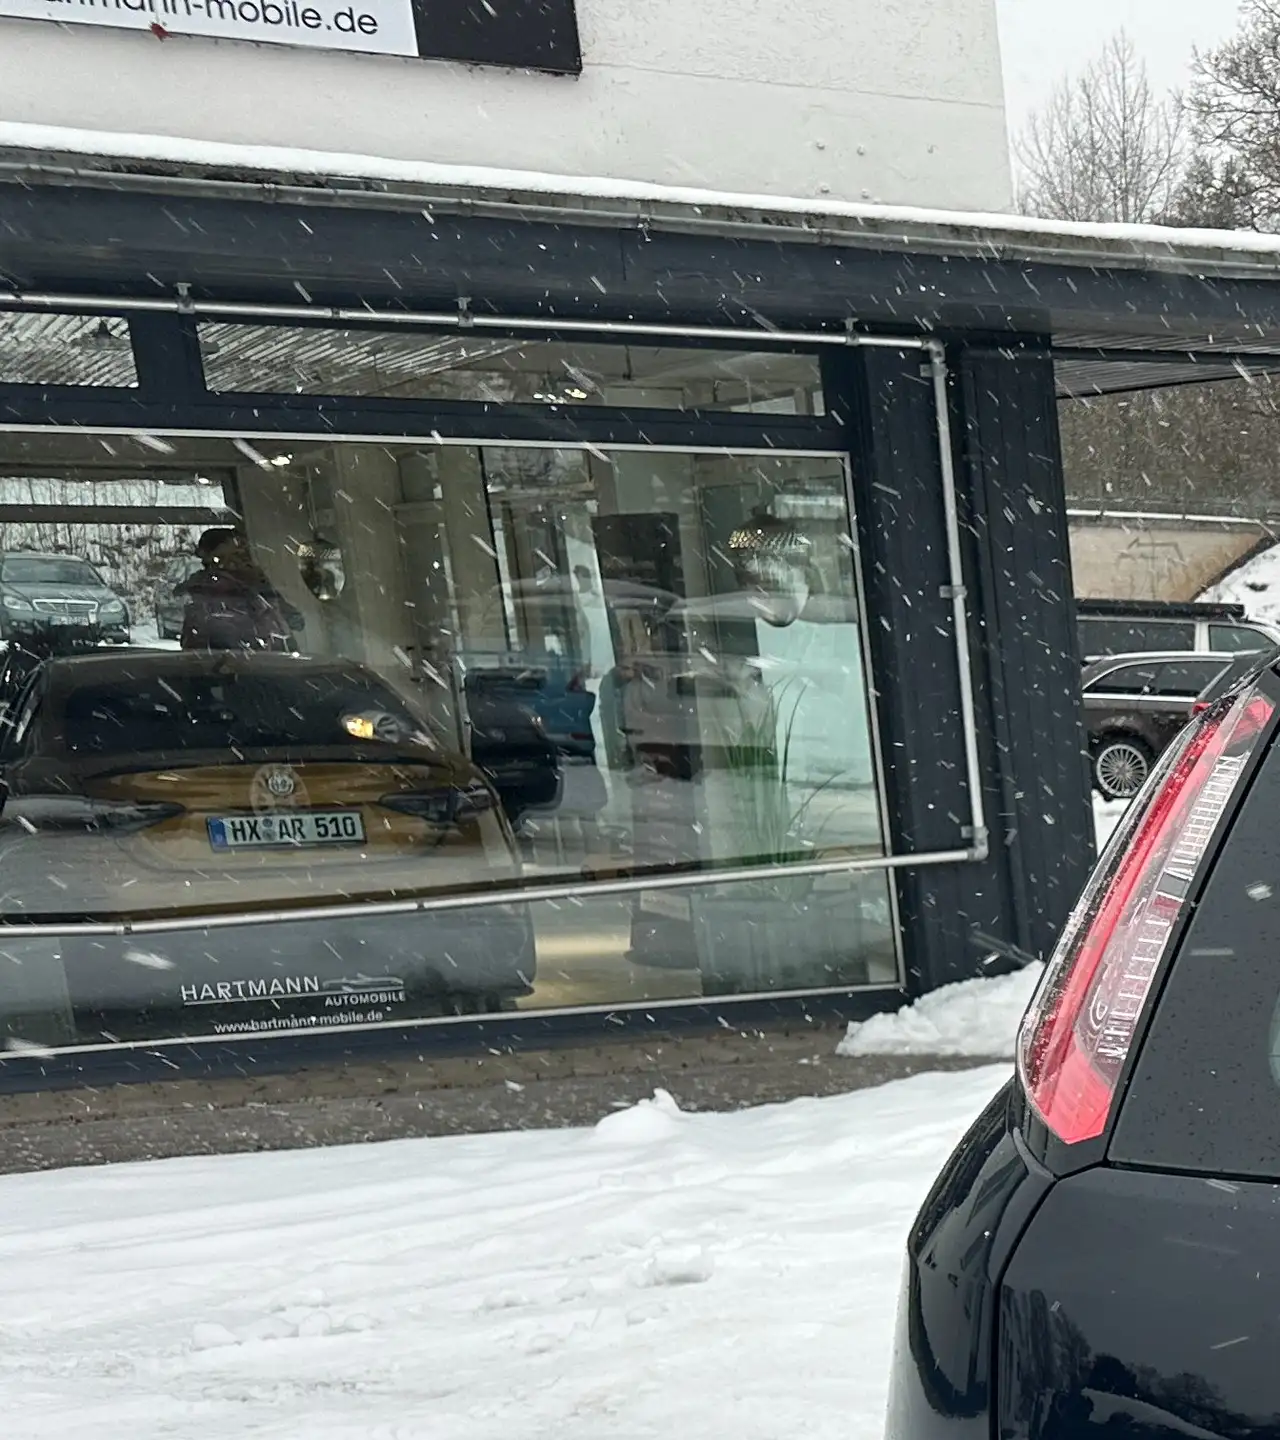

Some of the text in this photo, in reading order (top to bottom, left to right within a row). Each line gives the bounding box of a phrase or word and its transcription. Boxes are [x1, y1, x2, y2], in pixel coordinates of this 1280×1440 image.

[231, 816, 357, 842] HX AR 510
[181, 976, 320, 1001] HARTMANN
[325, 991, 406, 1007] AUTOMOBILE
